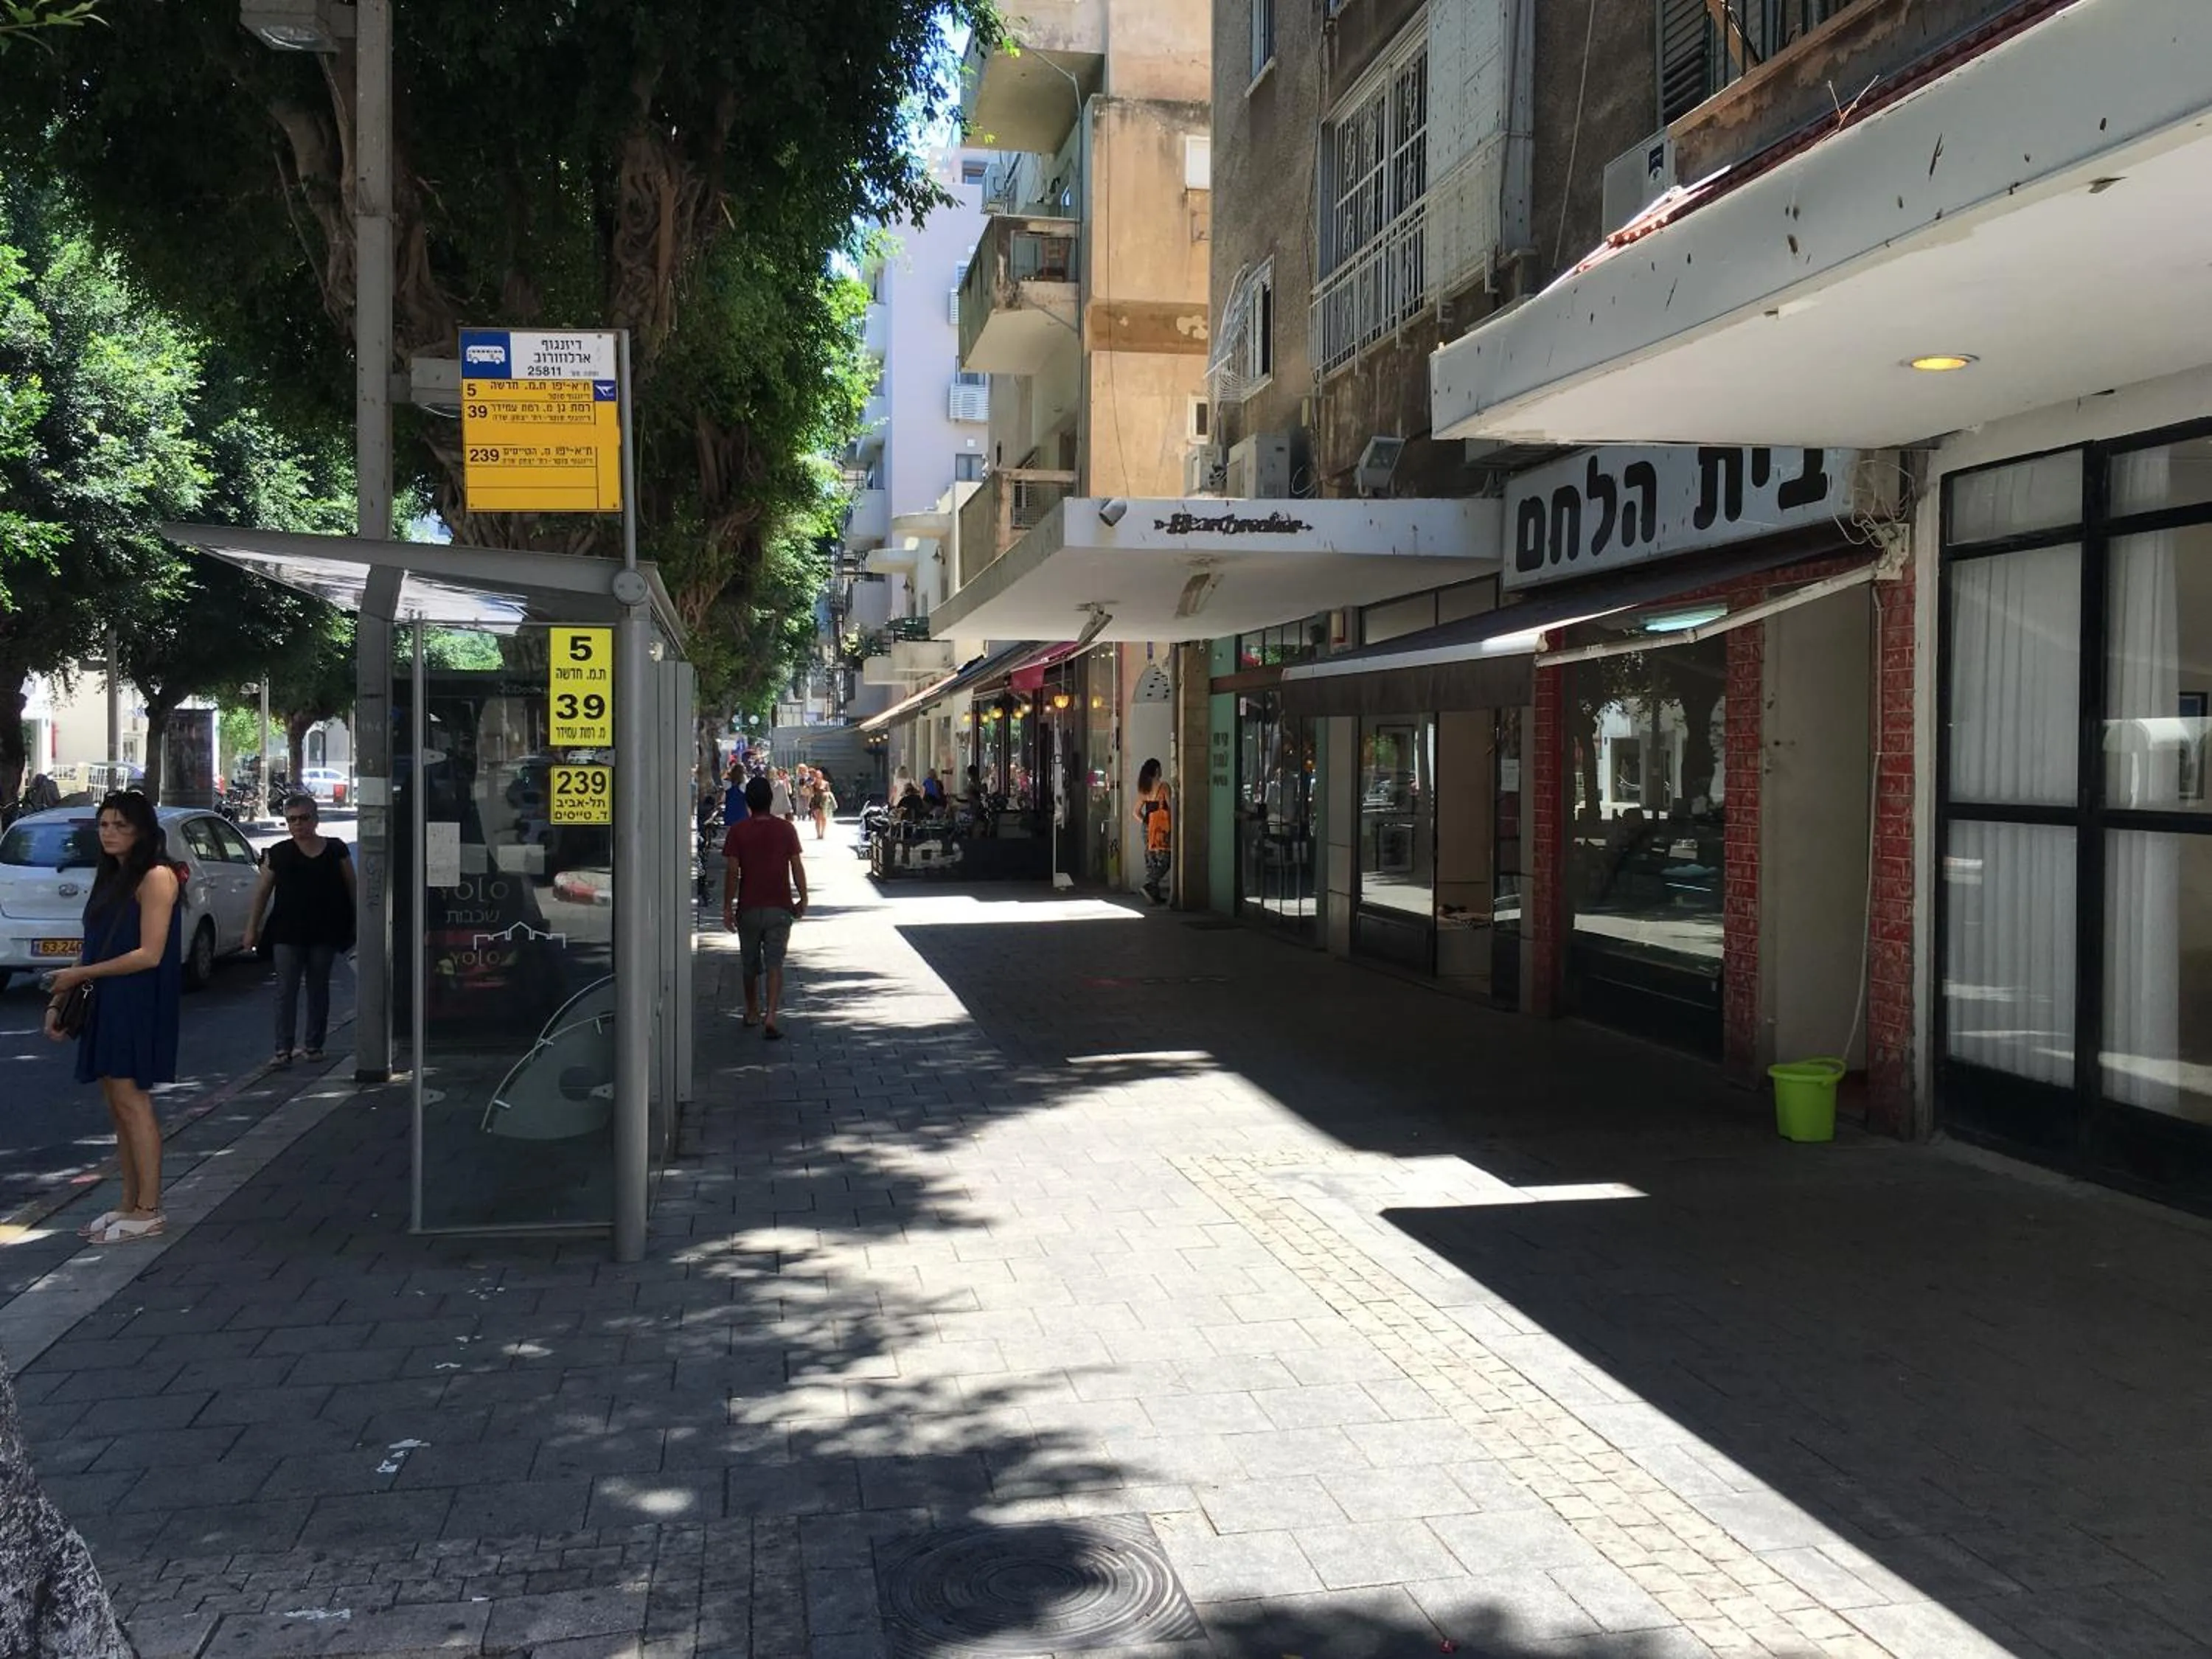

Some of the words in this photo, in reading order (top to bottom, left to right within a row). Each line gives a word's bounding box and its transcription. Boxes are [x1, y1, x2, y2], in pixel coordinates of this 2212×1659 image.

[541, 339, 582, 351] דיזנגוף
[533, 352, 591, 364] ארלוזורוב
[527, 366, 562, 377] 25811
[466, 383, 478, 397] 5
[490, 380, 518, 390] חדשה
[467, 405, 488, 419] 39
[557, 403, 566, 414] גן
[570, 403, 591, 412] רמת
[469, 448, 500, 462] 239
[1692, 448, 1829, 531] בית
[1514, 454, 1658, 573] הלחם
[569, 635, 593, 661] 5
[555, 667, 583, 680] חדשה
[555, 693, 606, 720] 39
[557, 771, 607, 795] 239
[555, 796, 605, 808] תל-אביב
